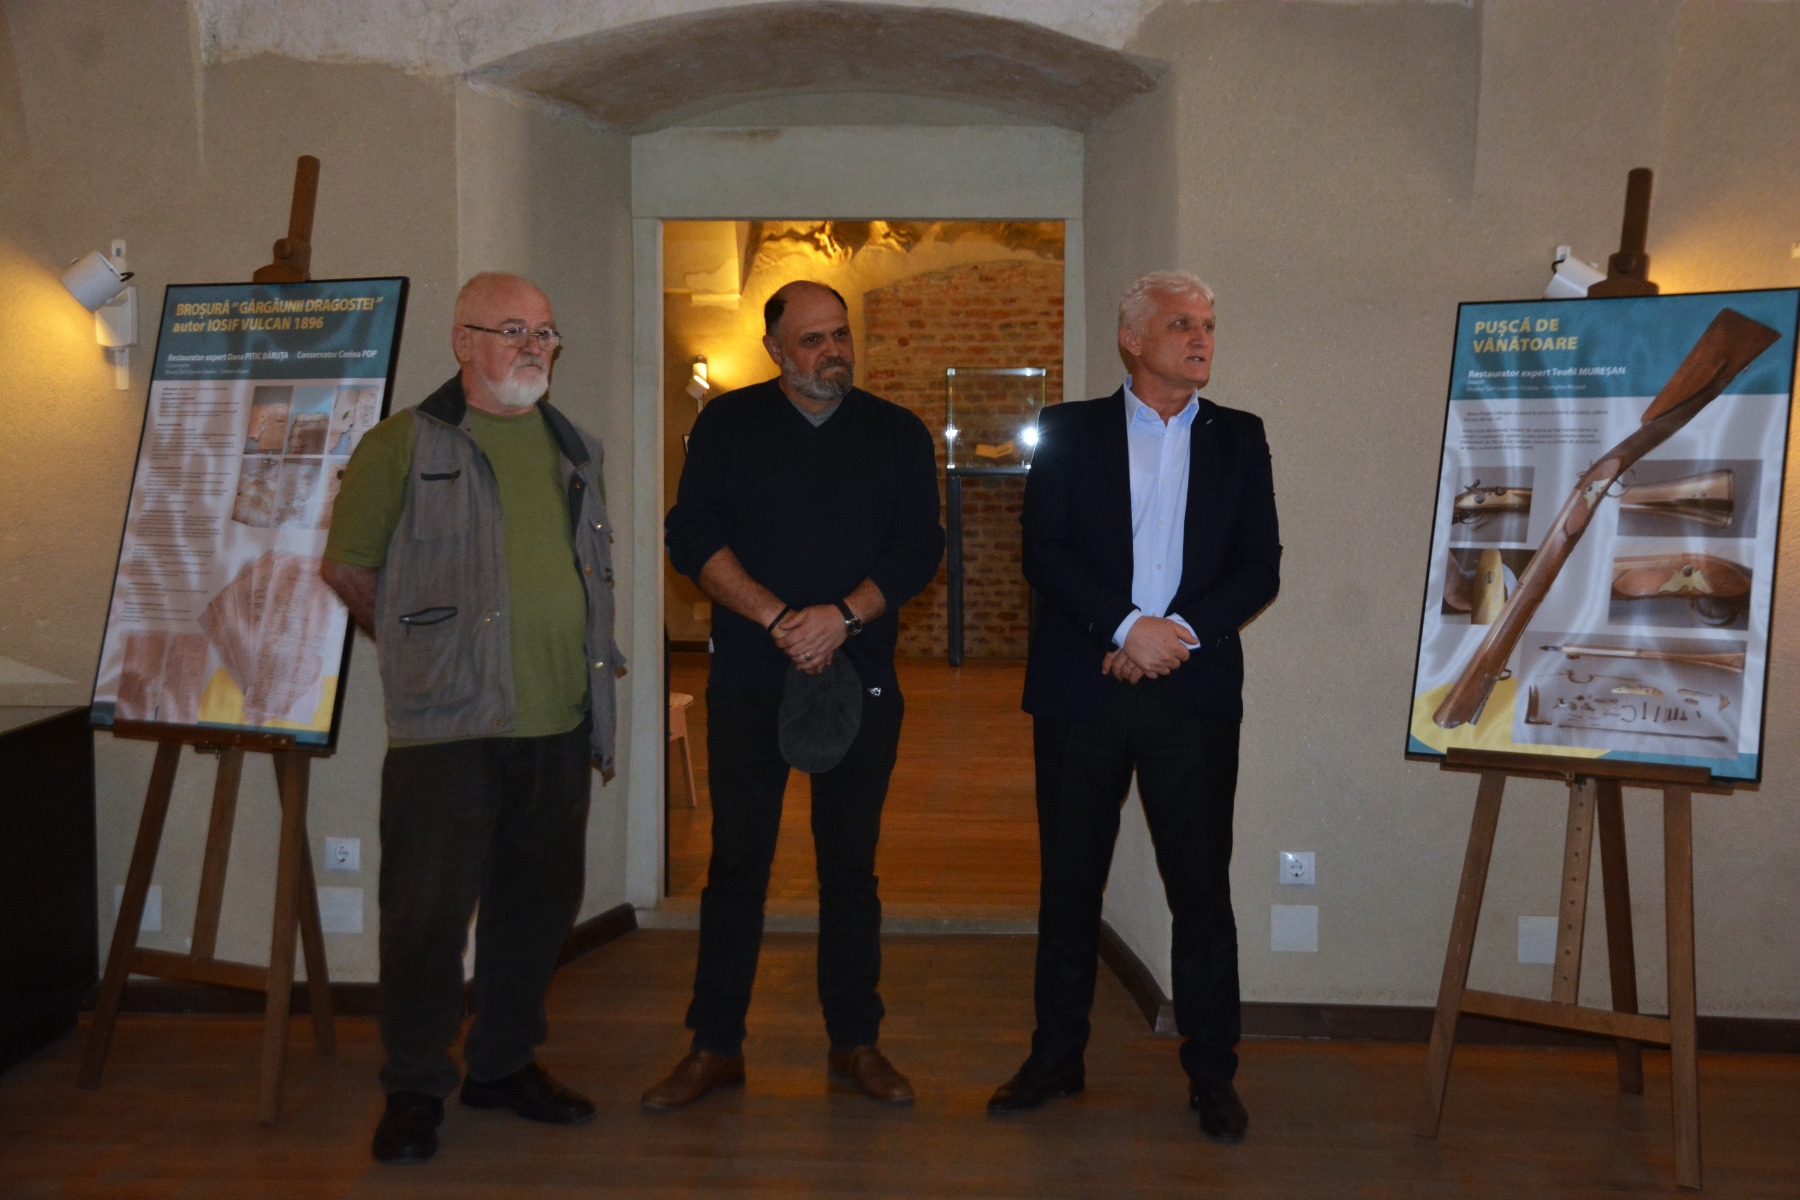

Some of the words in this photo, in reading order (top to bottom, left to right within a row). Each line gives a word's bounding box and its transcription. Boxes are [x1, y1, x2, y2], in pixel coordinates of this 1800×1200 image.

[176, 299, 230, 319] BROȘURĂ
[173, 320, 206, 333] autor
[207, 318, 240, 332] IOSIF
[241, 317, 292, 331] VULCAN
[294, 316, 324, 330] 1896
[1475, 317, 1531, 337] PUȘCĂ
[1535, 318, 1560, 332] DE
[1473, 335, 1578, 353] VÂNĂTOARE
[168, 354, 205, 362] Restaurator
[205, 353, 227, 362] expert
[297, 351, 338, 359] Conservator
[338, 350, 361, 359] Corina
[361, 350, 378, 358] POP
[1468, 368, 1520, 379] Restaurator
[1521, 368, 1551, 380] expert
[1552, 367, 1578, 377] Teofil
[1578, 365, 1626, 378] MUREȘAN
